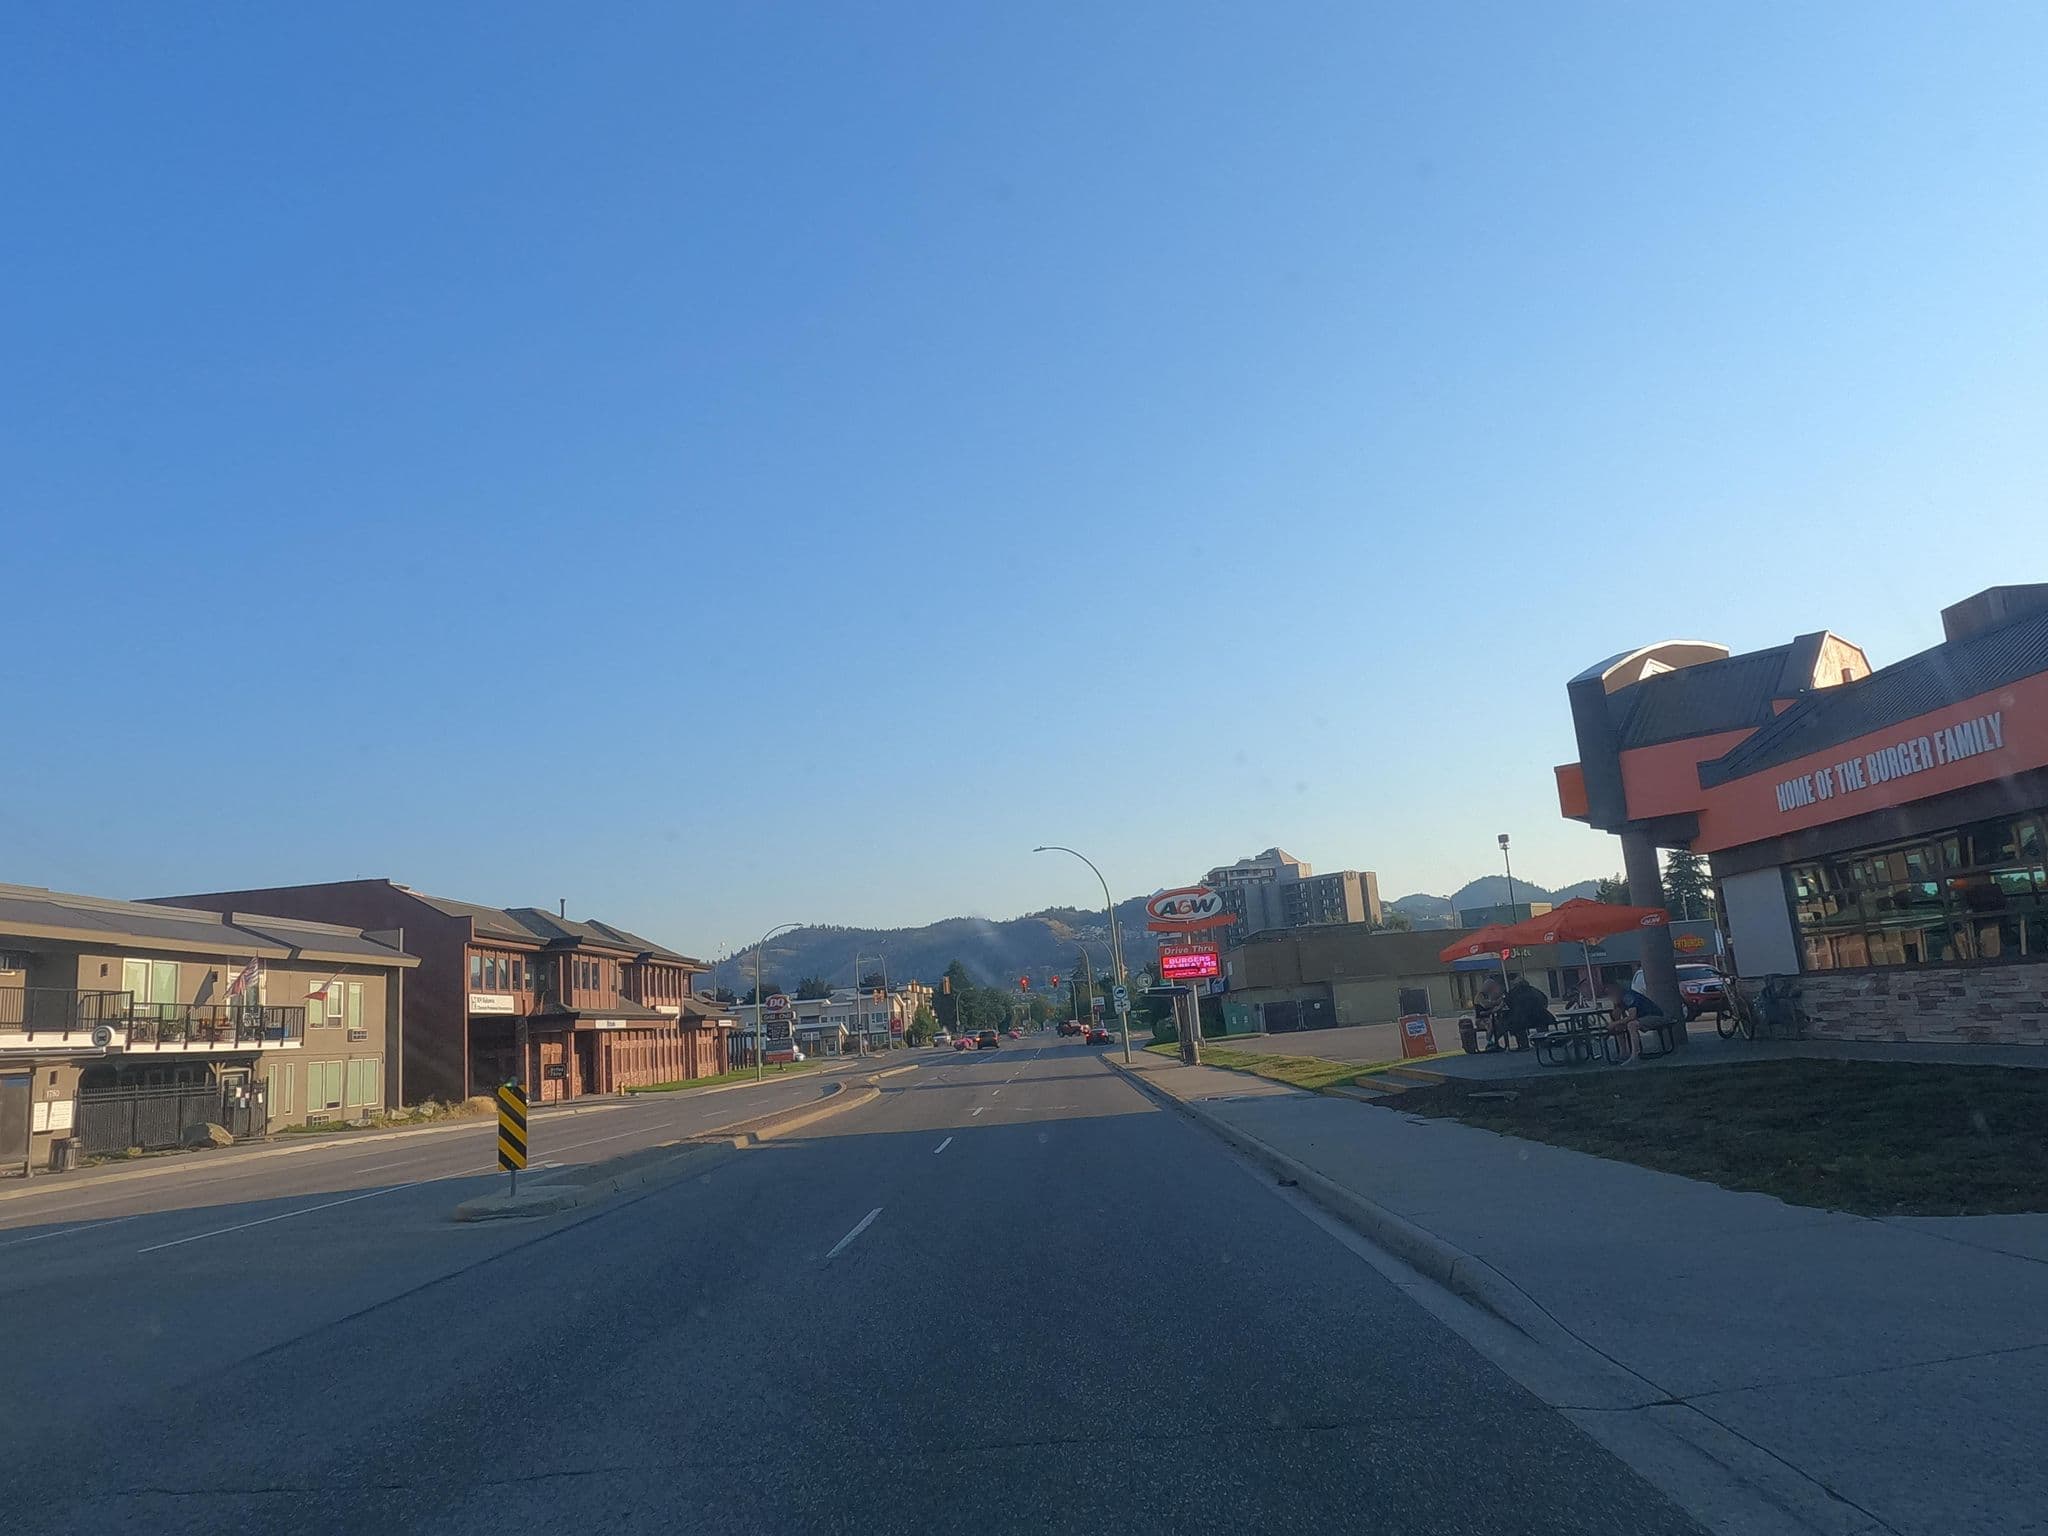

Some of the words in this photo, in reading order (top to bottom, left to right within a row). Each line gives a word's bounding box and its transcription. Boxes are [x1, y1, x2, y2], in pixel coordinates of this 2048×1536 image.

[1775, 775, 1816, 812] HOME
[1815, 767, 1834, 800] OF
[1835, 757, 1867, 794] THE
[1865, 735, 1935, 785] BURGER
[1933, 711, 2003, 765] FAMILY
[1160, 897, 1216, 915] A&W
[1164, 946, 1189, 955] Drive
[1192, 945, 1214, 953] Thru
[1169, 955, 1211, 965] BURGERS
[769, 998, 785, 1008] DQ
